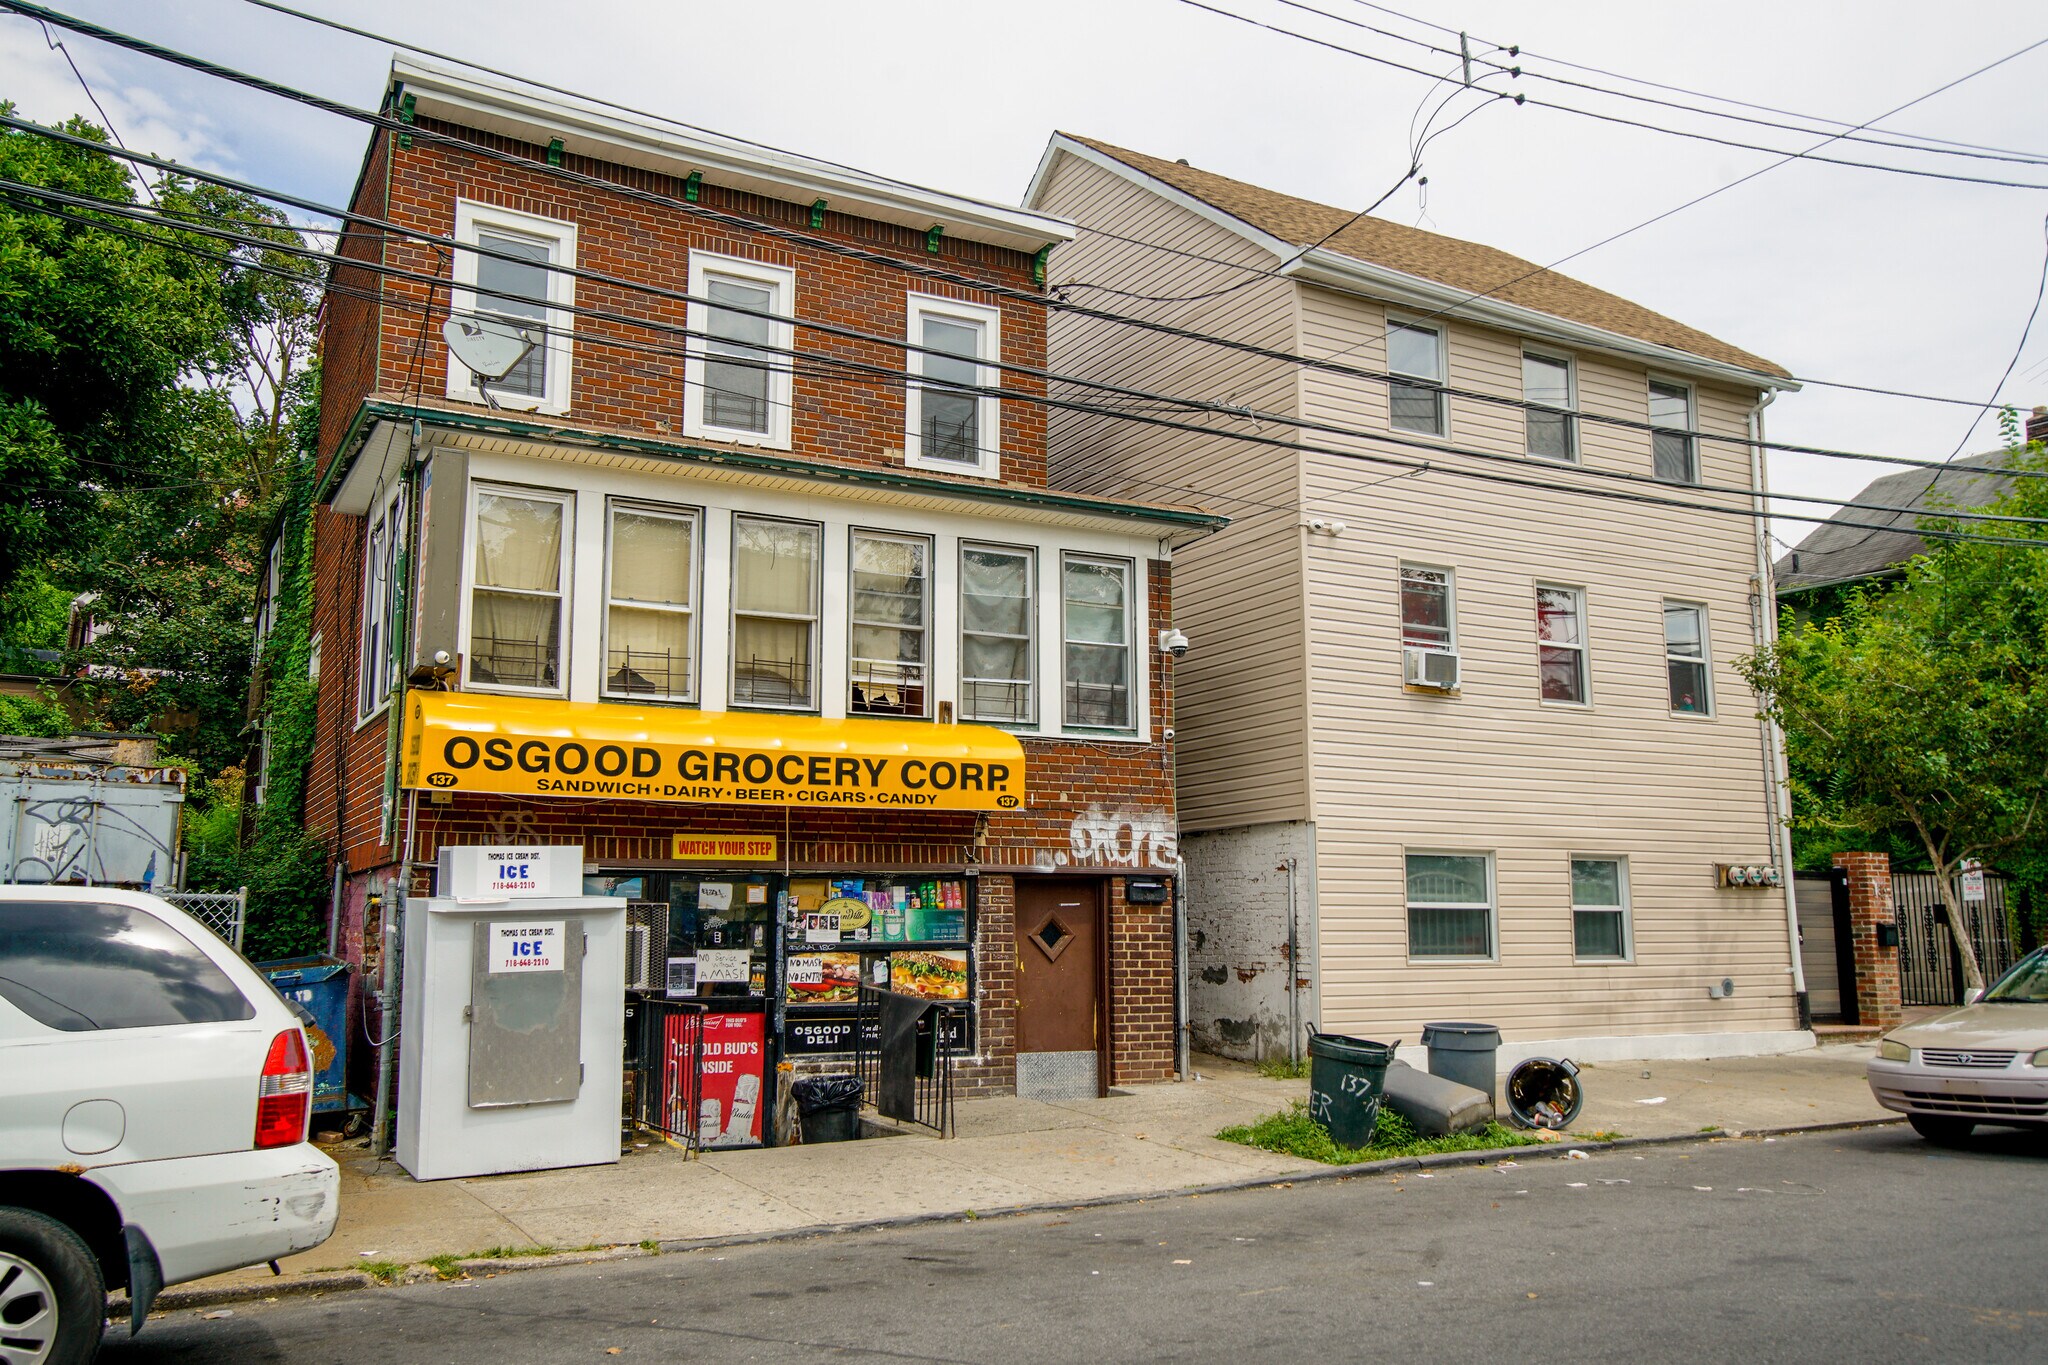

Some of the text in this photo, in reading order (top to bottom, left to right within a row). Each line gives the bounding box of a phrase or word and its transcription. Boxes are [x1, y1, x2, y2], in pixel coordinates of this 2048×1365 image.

[443, 736, 662, 778] OSGOOD
[677, 750, 888, 788] GROCERY
[900, 760, 1010, 791] CORP.
[431, 774, 454, 785] 137
[537, 778, 938, 805] SANDWICH DAIRY BEER CIGARS CANDY
[999, 796, 1016, 806] 137
[679, 841, 772, 855] WATCH YOUR STEP
[515, 852, 529, 860] CREAM
[499, 864, 529, 879] ICE
[492, 882, 536, 890] 718-648-2210
[501, 929, 518, 937] THOMAS
[529, 928, 543, 936] CREAM
[512, 941, 543, 956] ICE
[505, 958, 550, 967] 718-648-2210
[698, 953, 710, 962] NO
[790, 958, 823, 967] NO MASK
[700, 969, 745, 980] A MASK
[788, 972, 799, 981] NO
[795, 1025, 851, 1035] OSGOOD
[807, 1035, 838, 1044] DELI
[724, 1042, 758, 1055] BUD'S
[698, 1060, 733, 1074] NSIDE
[1340, 1074, 1371, 1097] 137
